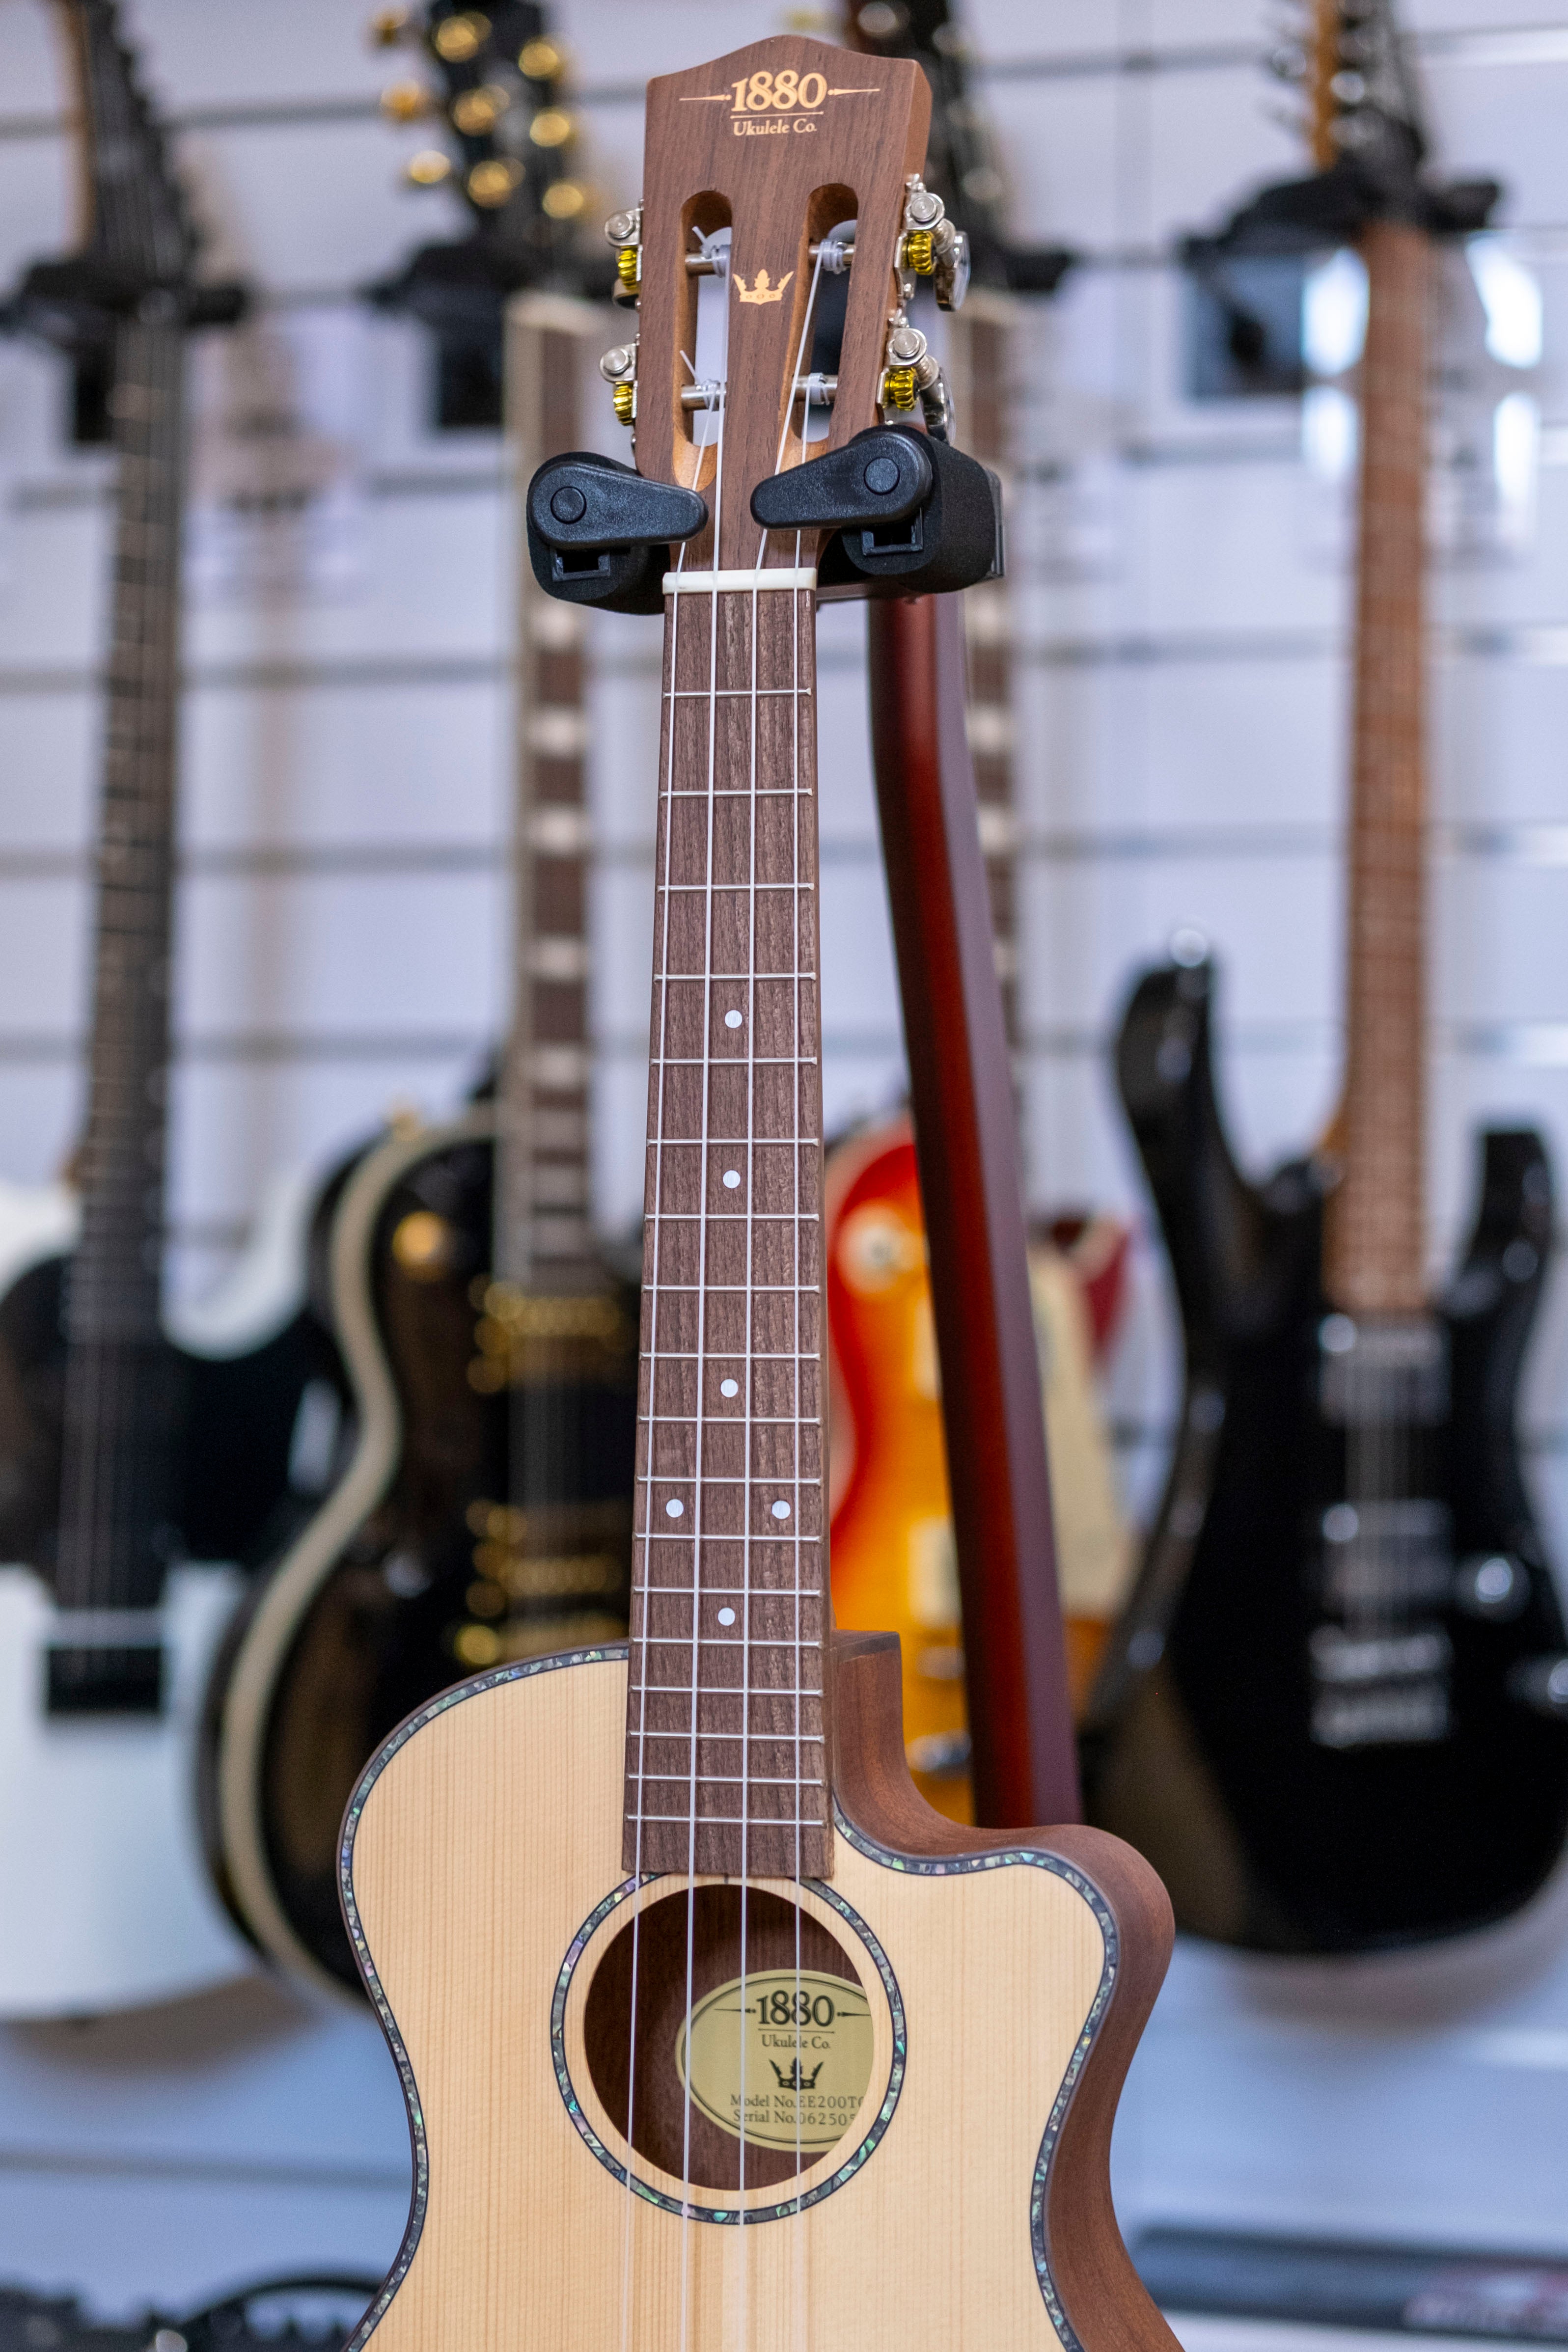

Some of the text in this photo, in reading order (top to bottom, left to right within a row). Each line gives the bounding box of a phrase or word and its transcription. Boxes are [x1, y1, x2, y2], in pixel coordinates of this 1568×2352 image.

[730, 70, 828, 111] 1880
[733, 118, 818, 136] Ukulele Co.
[756, 1990, 834, 2027] 1880
[762, 2034, 830, 2049] Ukulele Co.
[730, 2094, 770, 2106] Model
[733, 2108, 770, 2122] Serial
